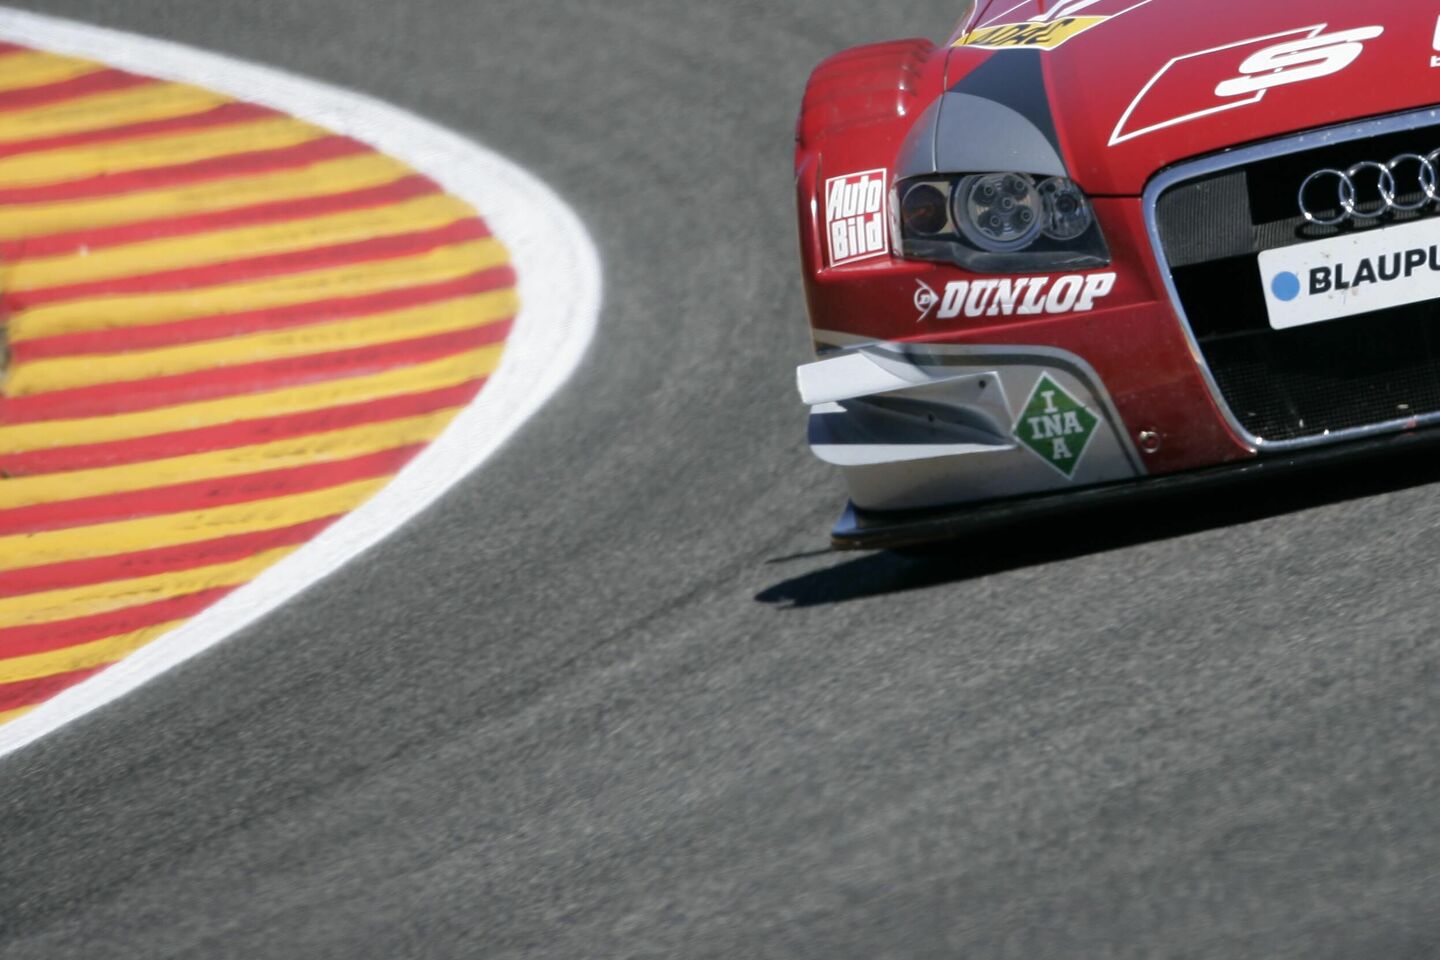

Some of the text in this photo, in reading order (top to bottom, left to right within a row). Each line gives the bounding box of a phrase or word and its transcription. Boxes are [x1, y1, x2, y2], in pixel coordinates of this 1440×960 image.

[1213, 24, 1385, 98] S
[827, 174, 883, 223] Auto
[831, 212, 884, 261] Bild
[936, 271, 1117, 319] DUNLOP
[1028, 413, 1083, 440] INA
